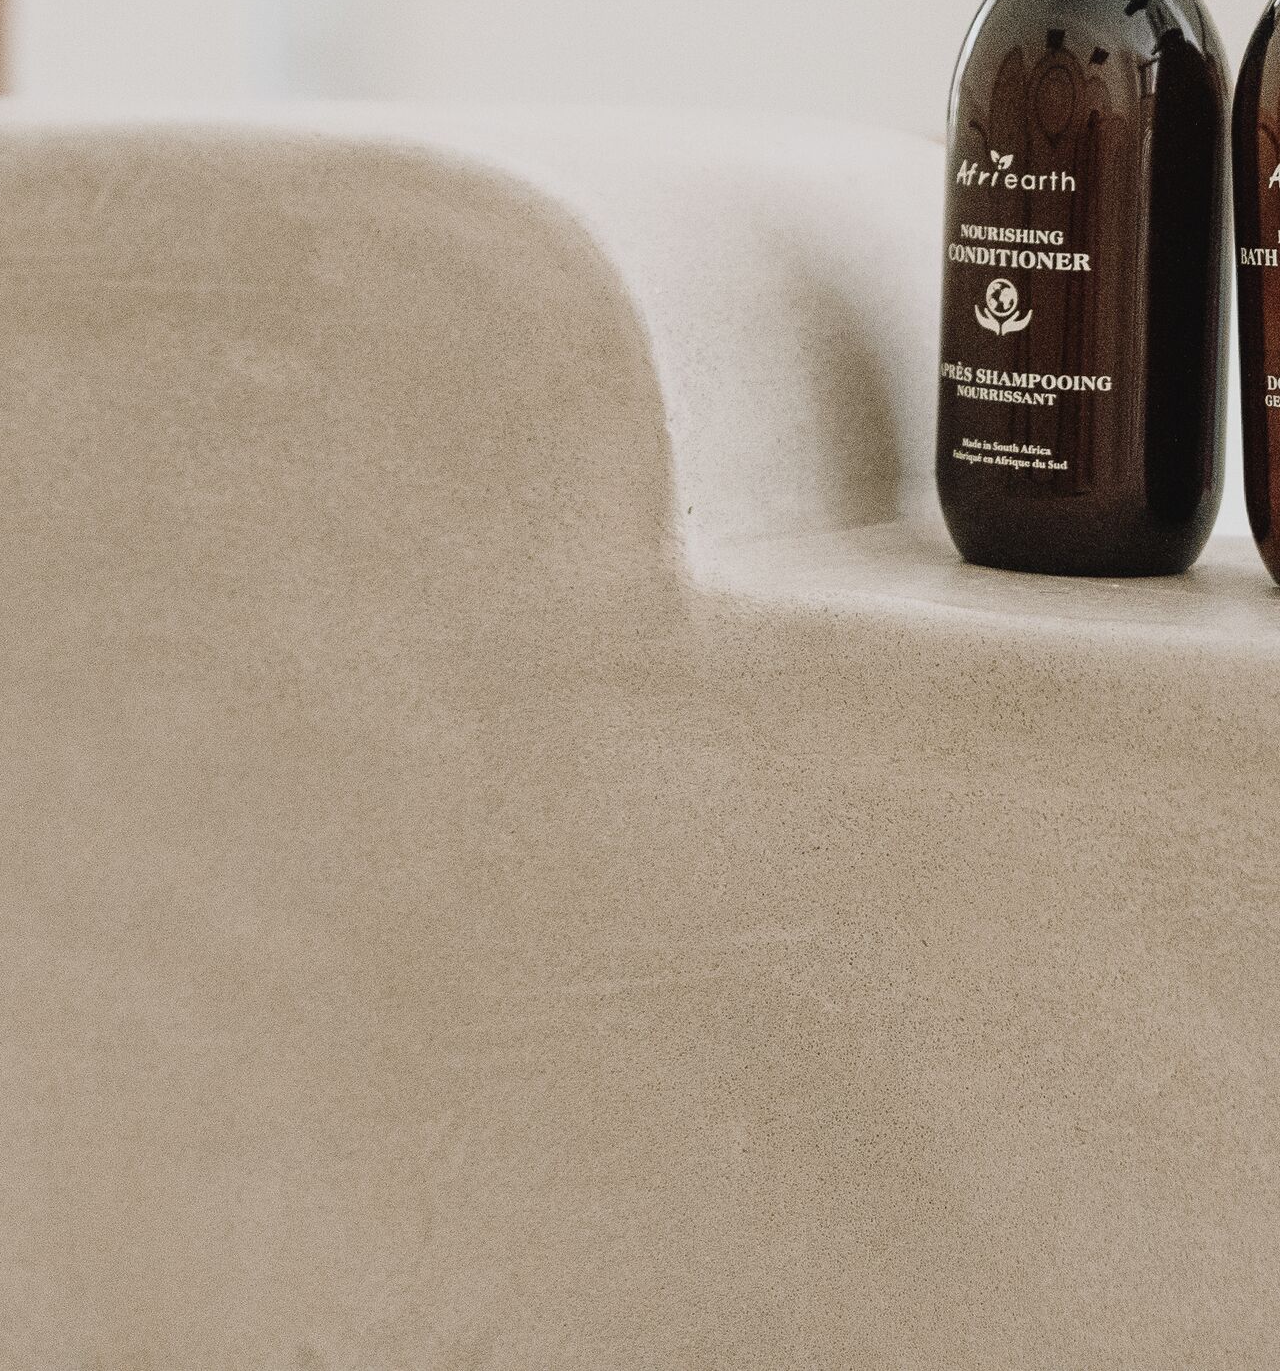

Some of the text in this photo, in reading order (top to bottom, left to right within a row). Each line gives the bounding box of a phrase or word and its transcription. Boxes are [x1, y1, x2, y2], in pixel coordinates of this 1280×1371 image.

[960, 224, 1064, 245] NOURISHING
[948, 243, 1091, 271] CONDITIONER
[1240, 247, 1277, 267] BATH
[976, 368, 1113, 392] SHAMPOOING
[957, 384, 1057, 406] NOURRISSANT
[962, 438, 1051, 456] Made in South Africa
[952, 450, 982, 464] Fabriqué
[995, 455, 1030, 469] Afrique
[1032, 459, 1046, 469] du
[1047, 460, 1068, 470] Sud
